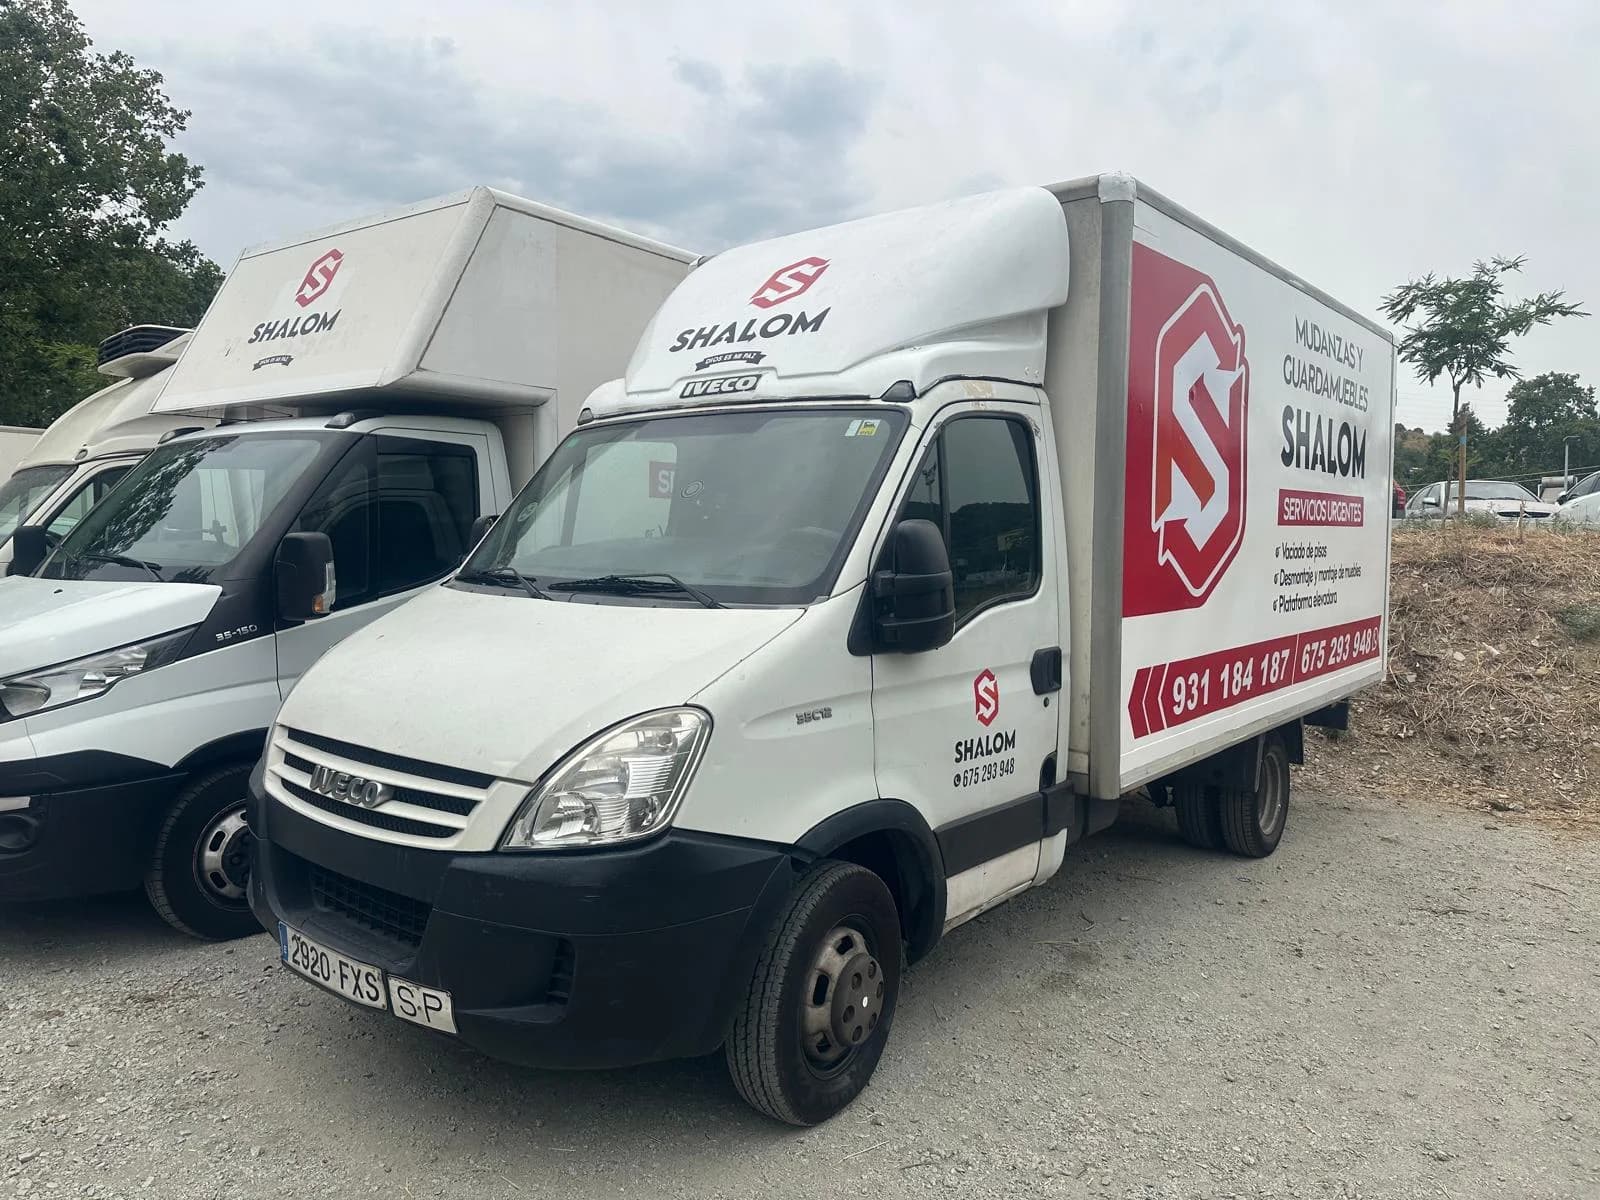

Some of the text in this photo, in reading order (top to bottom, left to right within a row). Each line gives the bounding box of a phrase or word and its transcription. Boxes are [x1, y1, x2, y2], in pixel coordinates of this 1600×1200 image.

[248, 309, 342, 344] SHALOM
[669, 307, 831, 352] SHALOM
[1295, 315, 1364, 373] MUDANZAS Y
[683, 376, 757, 396] IVECO
[1283, 354, 1369, 412] GUARDAMUEBLES
[1281, 405, 1367, 479] SHALOM
[1283, 497, 1361, 522] SERVICIOS URGENTES
[1282, 542, 1327, 562] Vaciado de pisos
[1280, 568, 1313, 587] Desmontaje
[1319, 565, 1337, 583] montaje
[1345, 563, 1361, 578] muebles
[1279, 589, 1337, 613] Plataforma elevadora
[215, 624, 258, 641] 35-150
[1301, 627, 1372, 674] 675 293 948
[1172, 649, 1290, 716] 931 184 187
[955, 729, 1015, 763] SHALOM
[309, 764, 384, 808] IVECO
[963, 757, 1015, 787] 675 293 948
